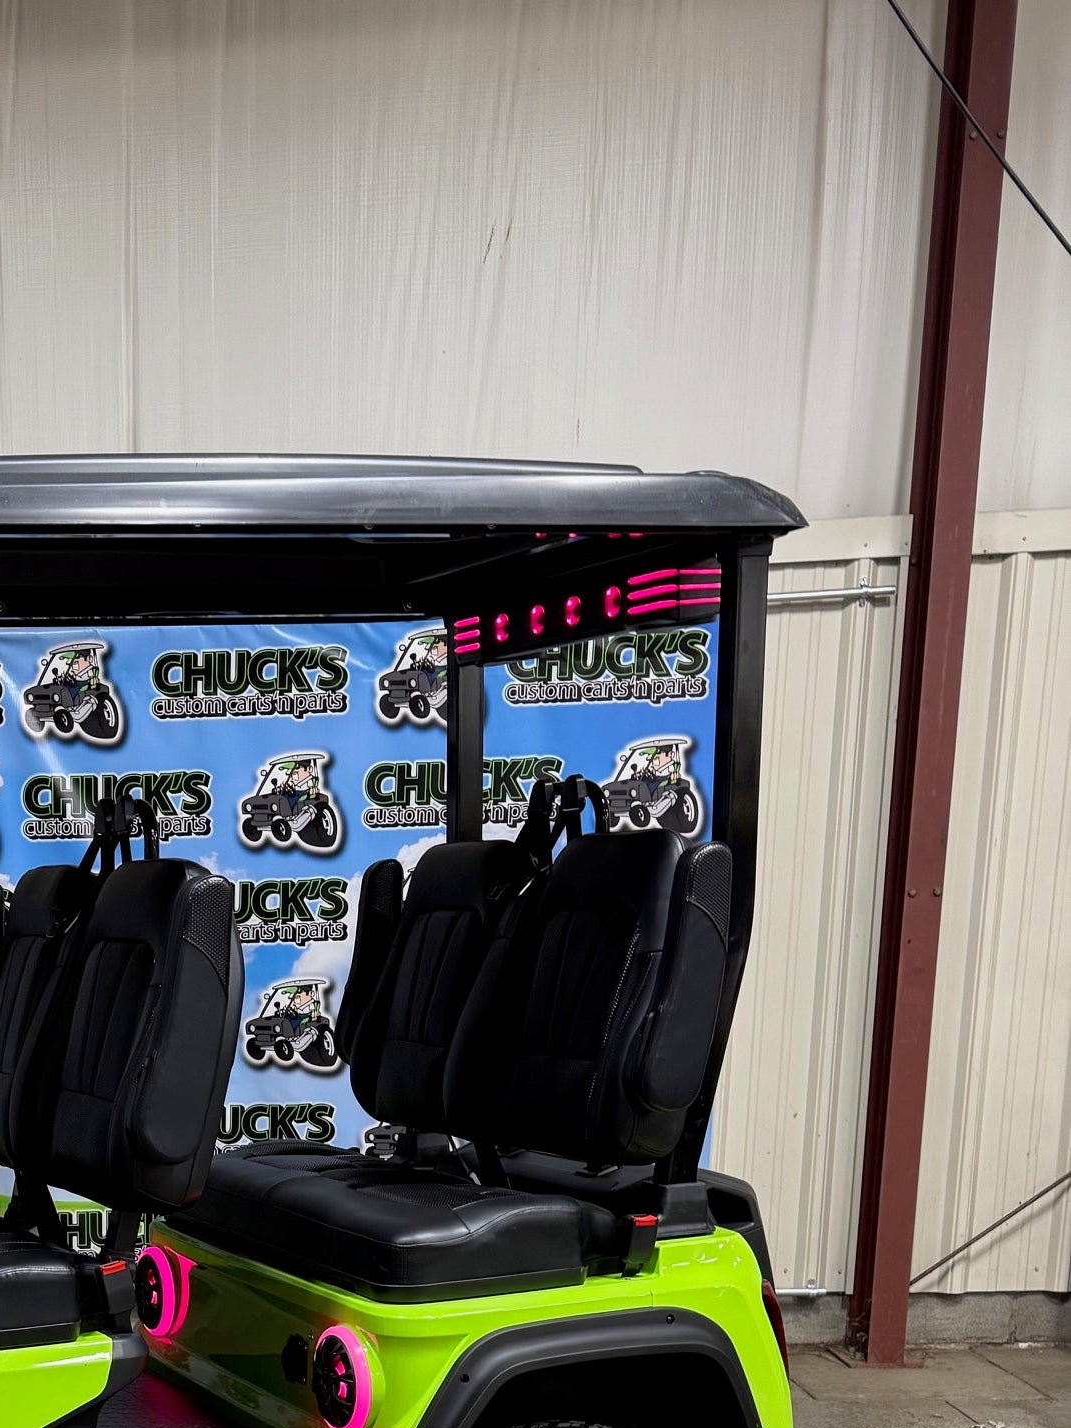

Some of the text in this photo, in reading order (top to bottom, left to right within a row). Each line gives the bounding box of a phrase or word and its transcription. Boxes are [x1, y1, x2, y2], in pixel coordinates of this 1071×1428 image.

[152, 646, 348, 697] CHUCK'S
[505, 681, 577, 700] custom
[652, 676, 701, 701] parts
[153, 697, 222, 715] custom
[294, 692, 342, 715] parts
[23, 819, 90, 836] custom
[159, 815, 206, 838] parts
[365, 807, 435, 825] custom
[296, 922, 343, 943] parts
